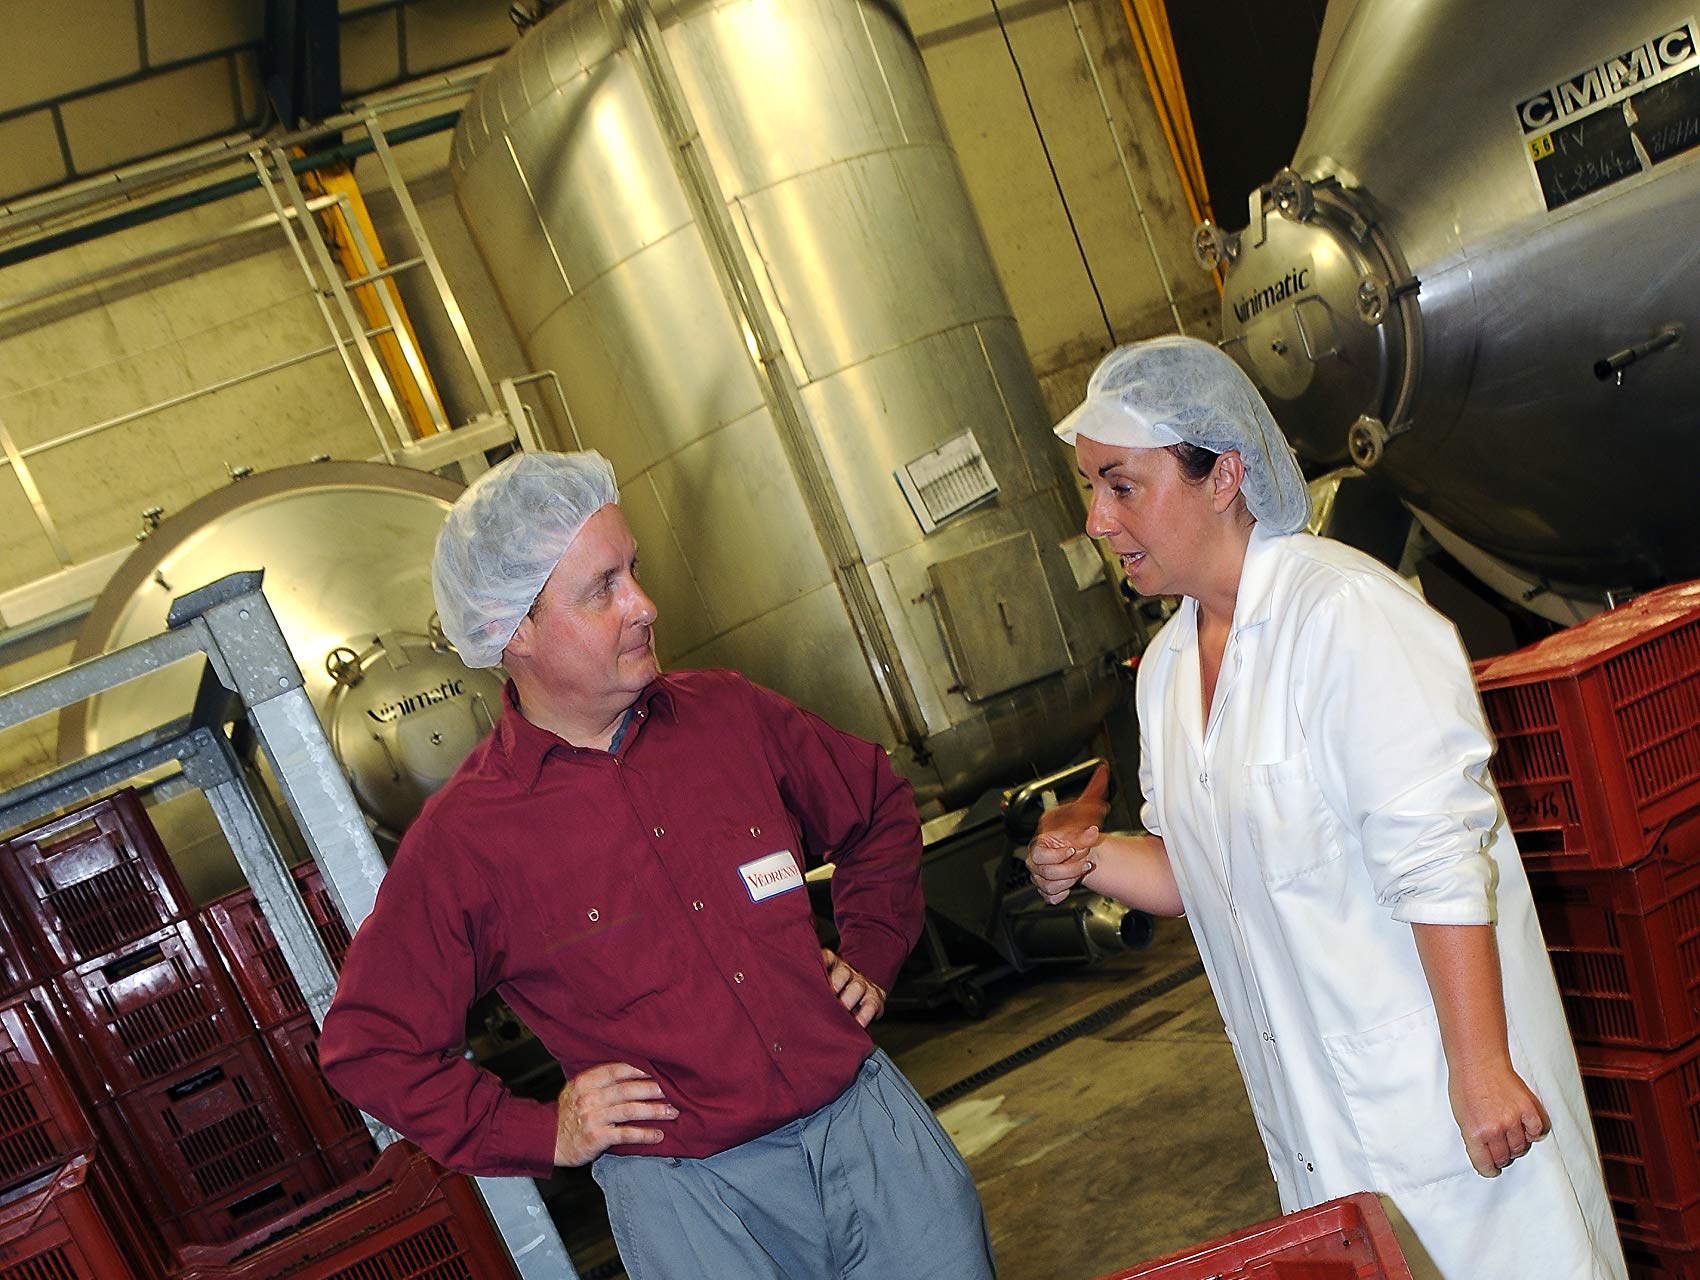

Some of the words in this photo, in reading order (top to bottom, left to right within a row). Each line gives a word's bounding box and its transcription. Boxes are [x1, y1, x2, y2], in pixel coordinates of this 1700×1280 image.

[1522, 30, 1691, 128] CMMC
[1233, 267, 1310, 324] Vinimatic
[366, 678, 466, 723] Vinimatic
[748, 865, 798, 888] VÉDRENN
